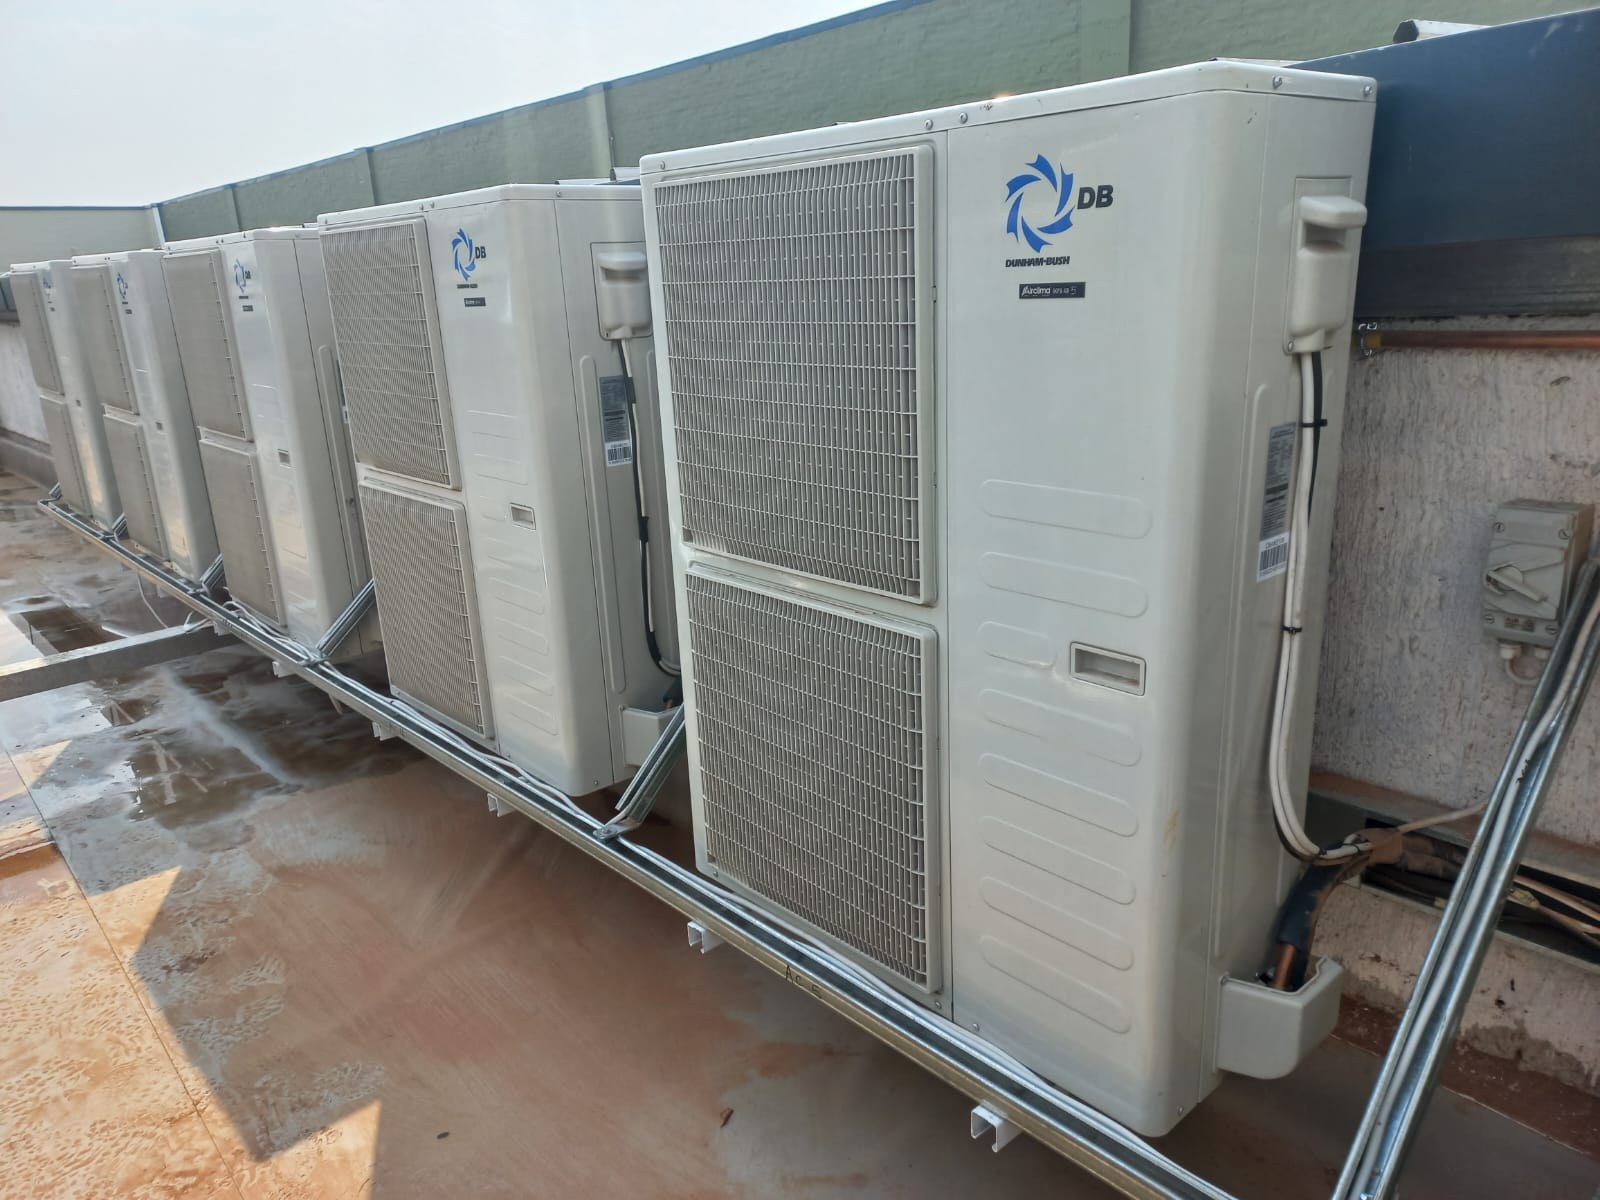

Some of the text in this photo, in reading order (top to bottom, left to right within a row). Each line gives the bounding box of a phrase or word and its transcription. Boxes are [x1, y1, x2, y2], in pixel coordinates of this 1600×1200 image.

[1077, 184, 1114, 210] DB
[474, 246, 487, 259] DB
[1005, 256, 1071, 267] DUNHAM-BUSH
